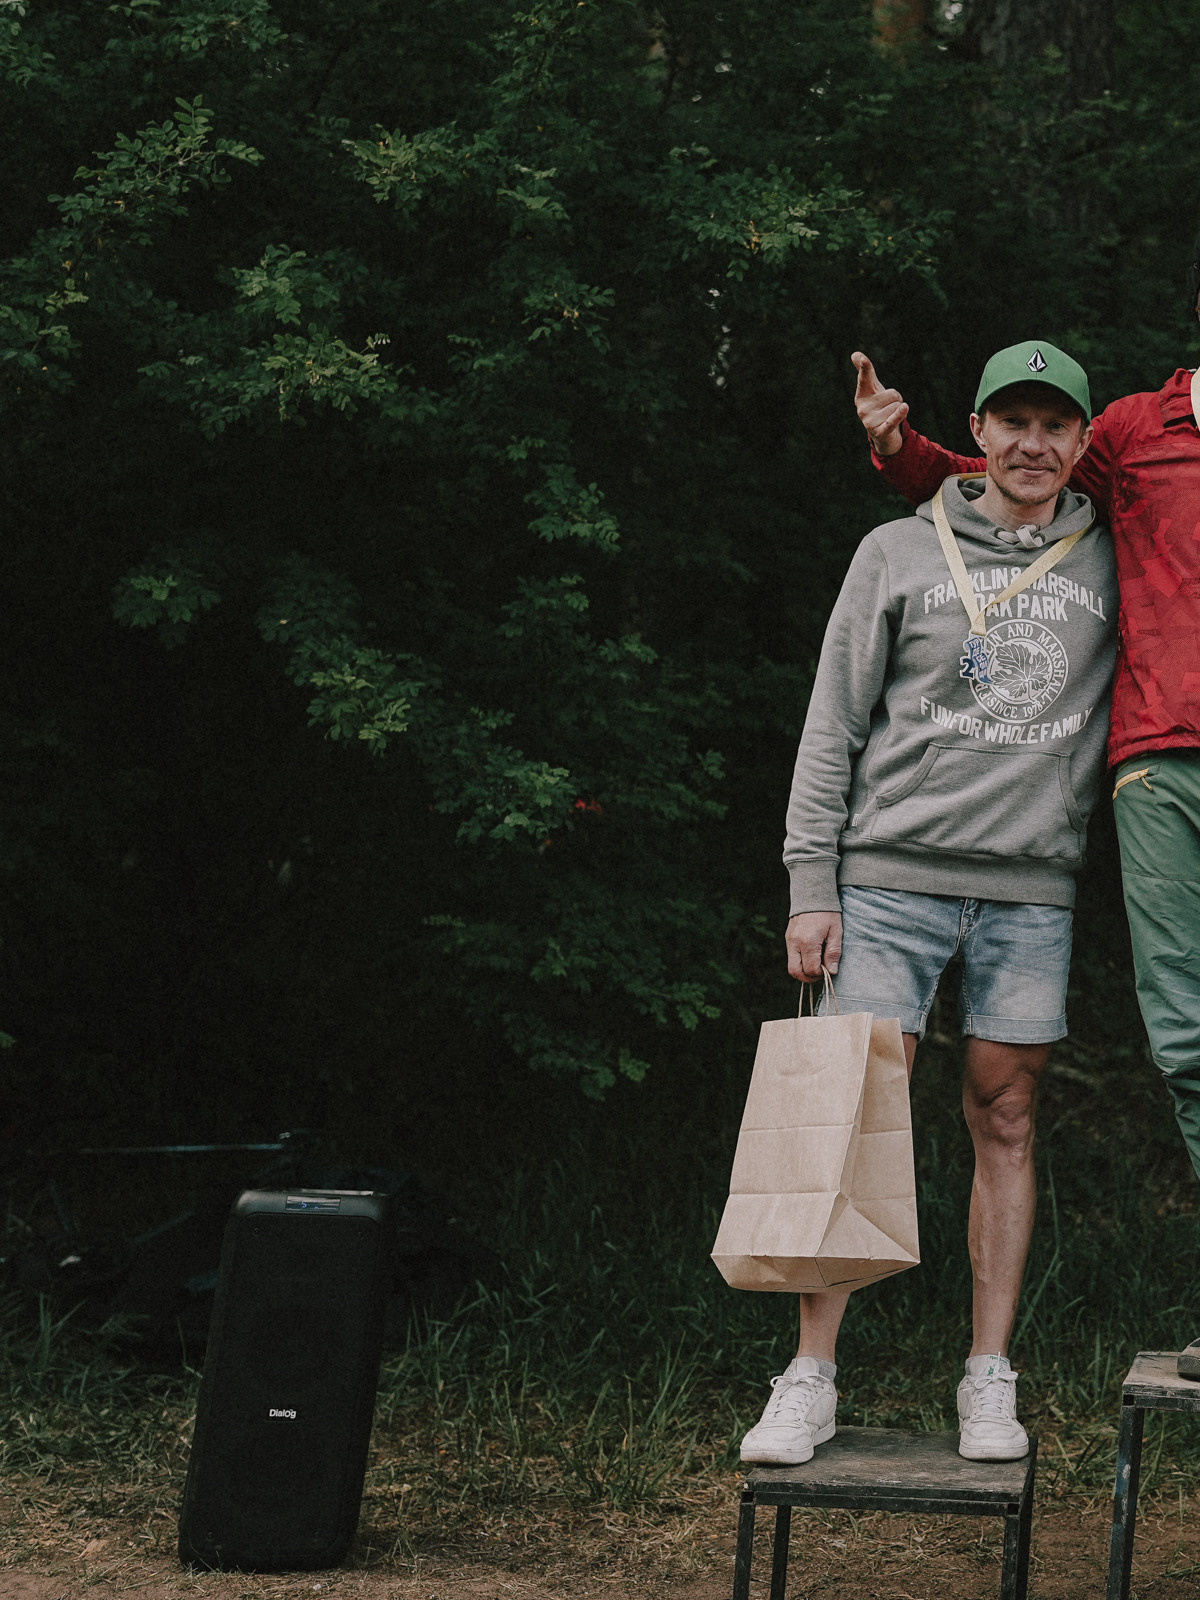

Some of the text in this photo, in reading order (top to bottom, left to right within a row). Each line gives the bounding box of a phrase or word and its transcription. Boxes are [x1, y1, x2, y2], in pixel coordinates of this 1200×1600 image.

[923, 567, 1009, 615] FRAKLIN
[1017, 593, 1069, 621] PARK
[962, 657, 976, 678] 2
[1008, 623, 1034, 639] AND
[1036, 631, 1066, 702] MARSHALL
[986, 697, 1043, 719] SINCE 1978
[984, 721, 1040, 745] WHOLE
[269, 1408, 297, 1419] Dialog
